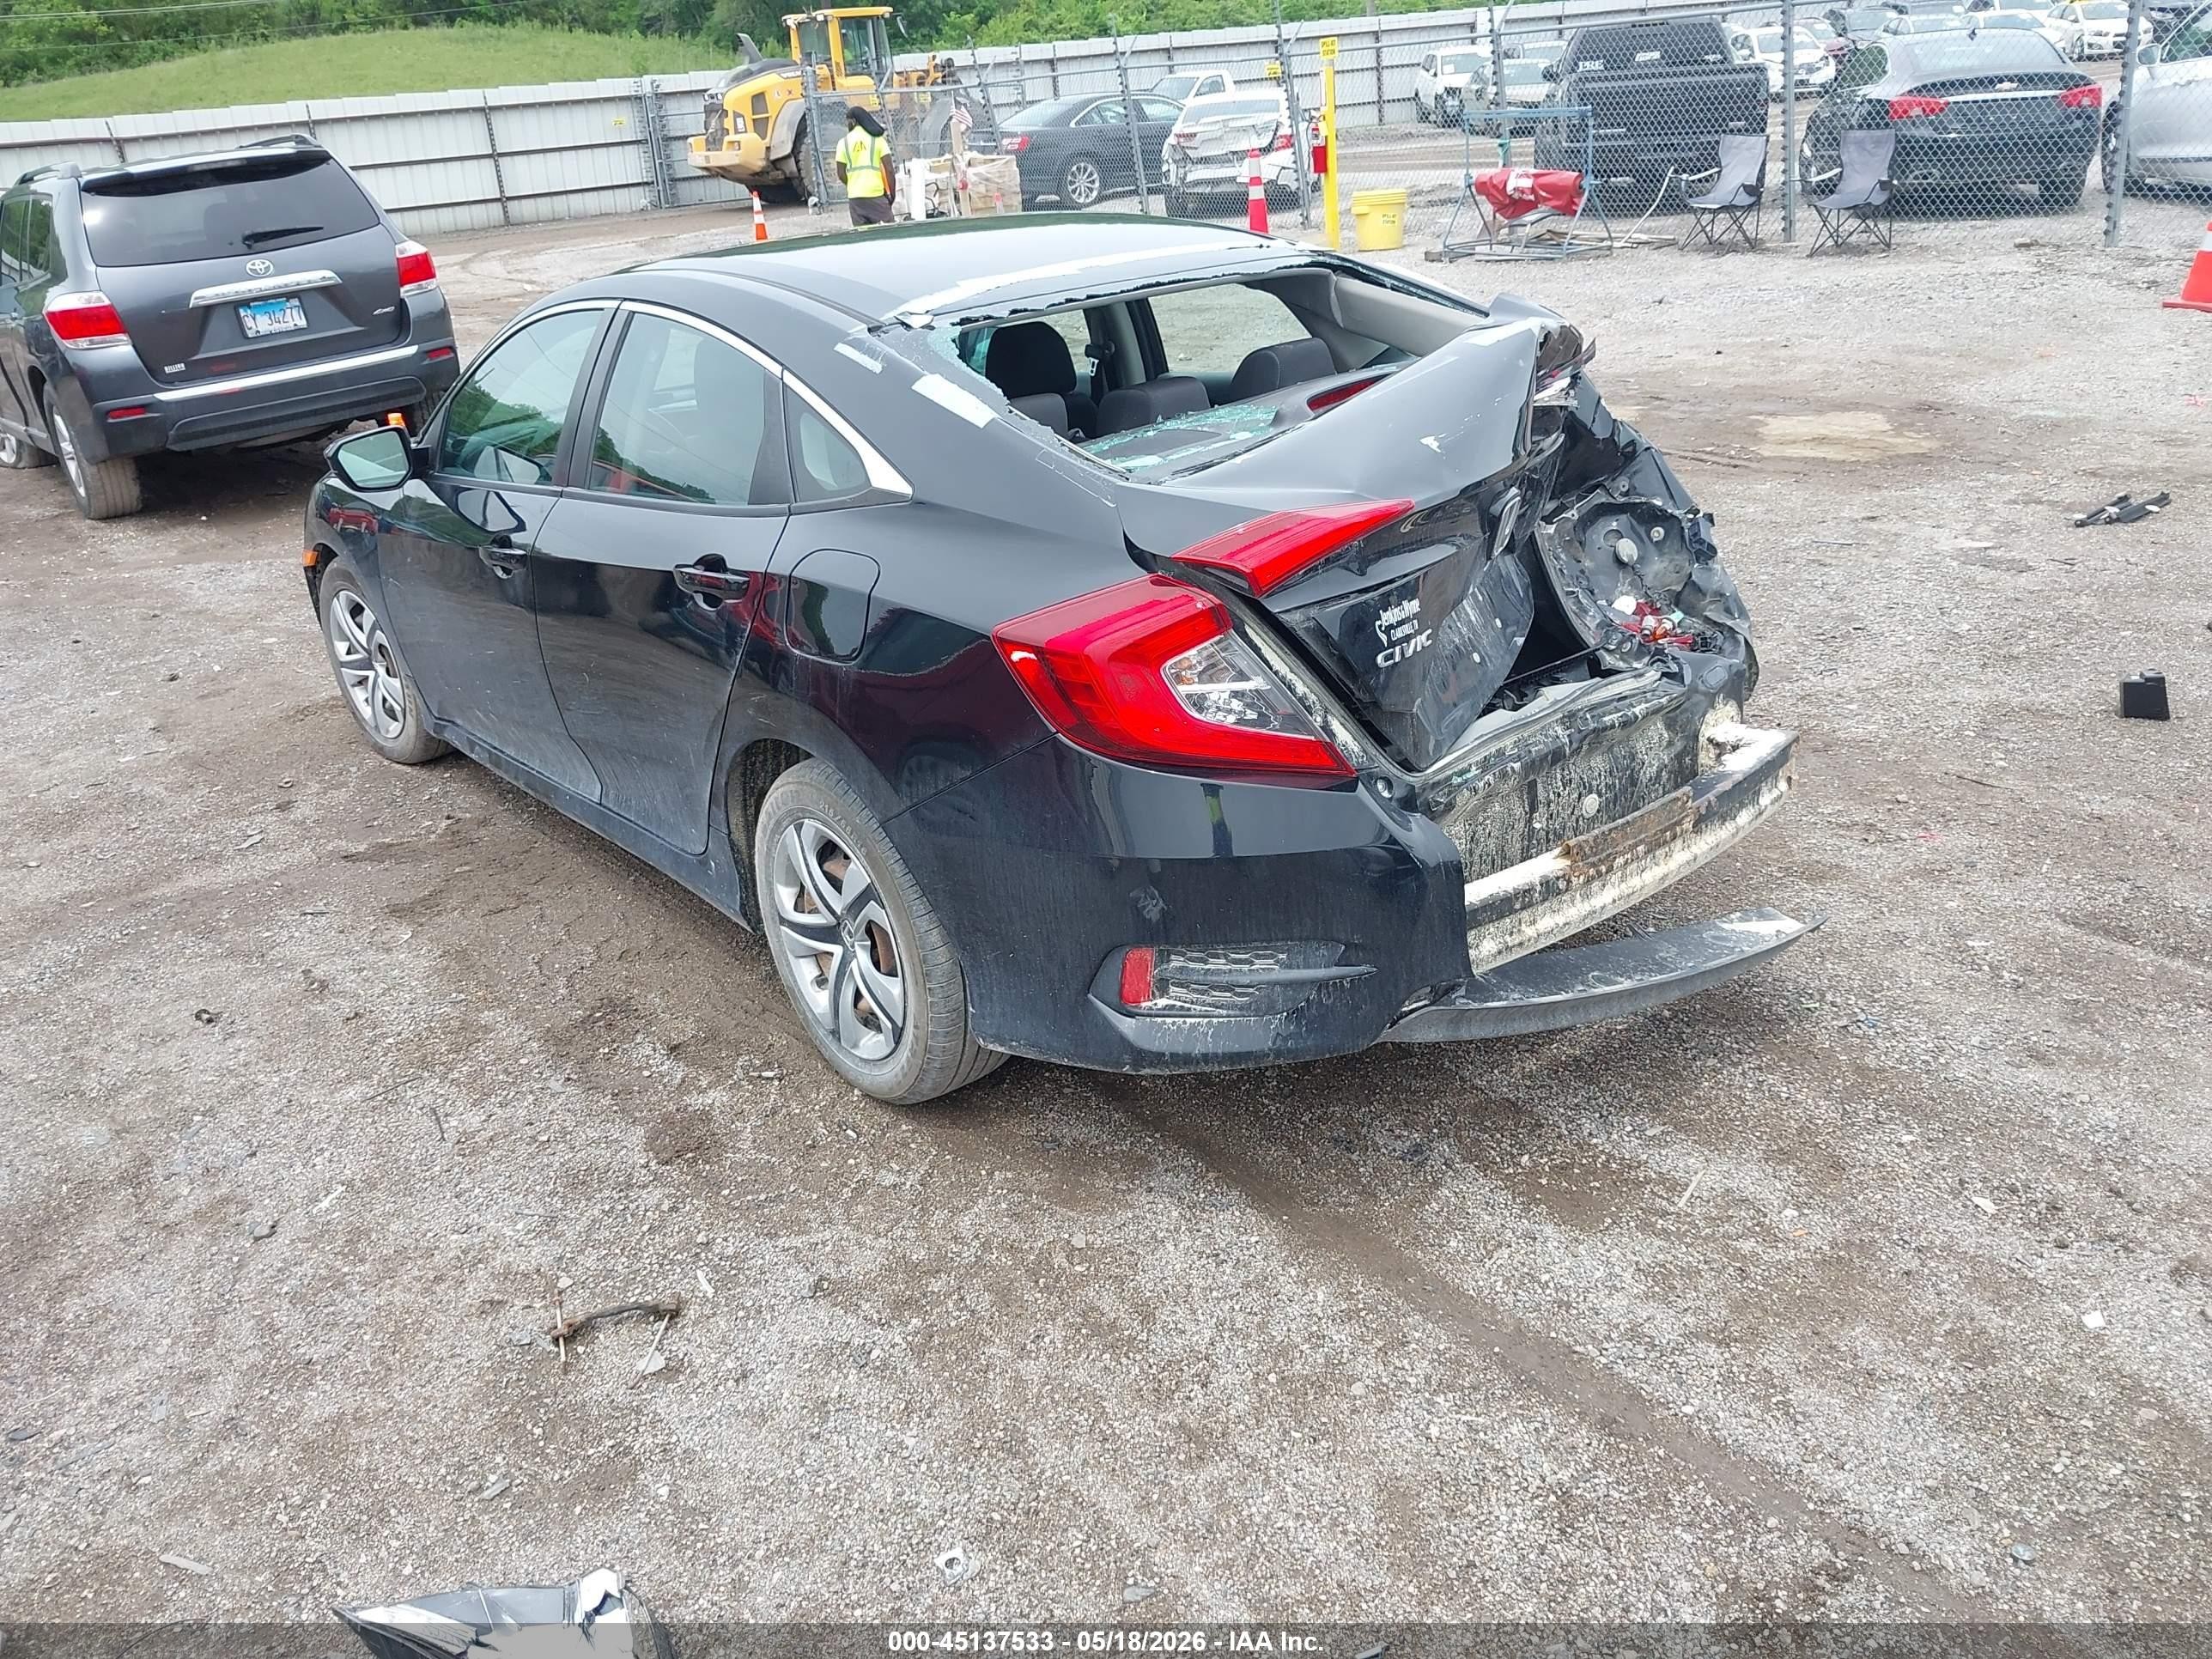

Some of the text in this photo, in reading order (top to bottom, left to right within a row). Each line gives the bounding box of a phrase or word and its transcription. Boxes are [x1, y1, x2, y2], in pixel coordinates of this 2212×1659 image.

[242, 305, 302, 331] CY 34277
[1376, 628, 1432, 668] CIVIC
